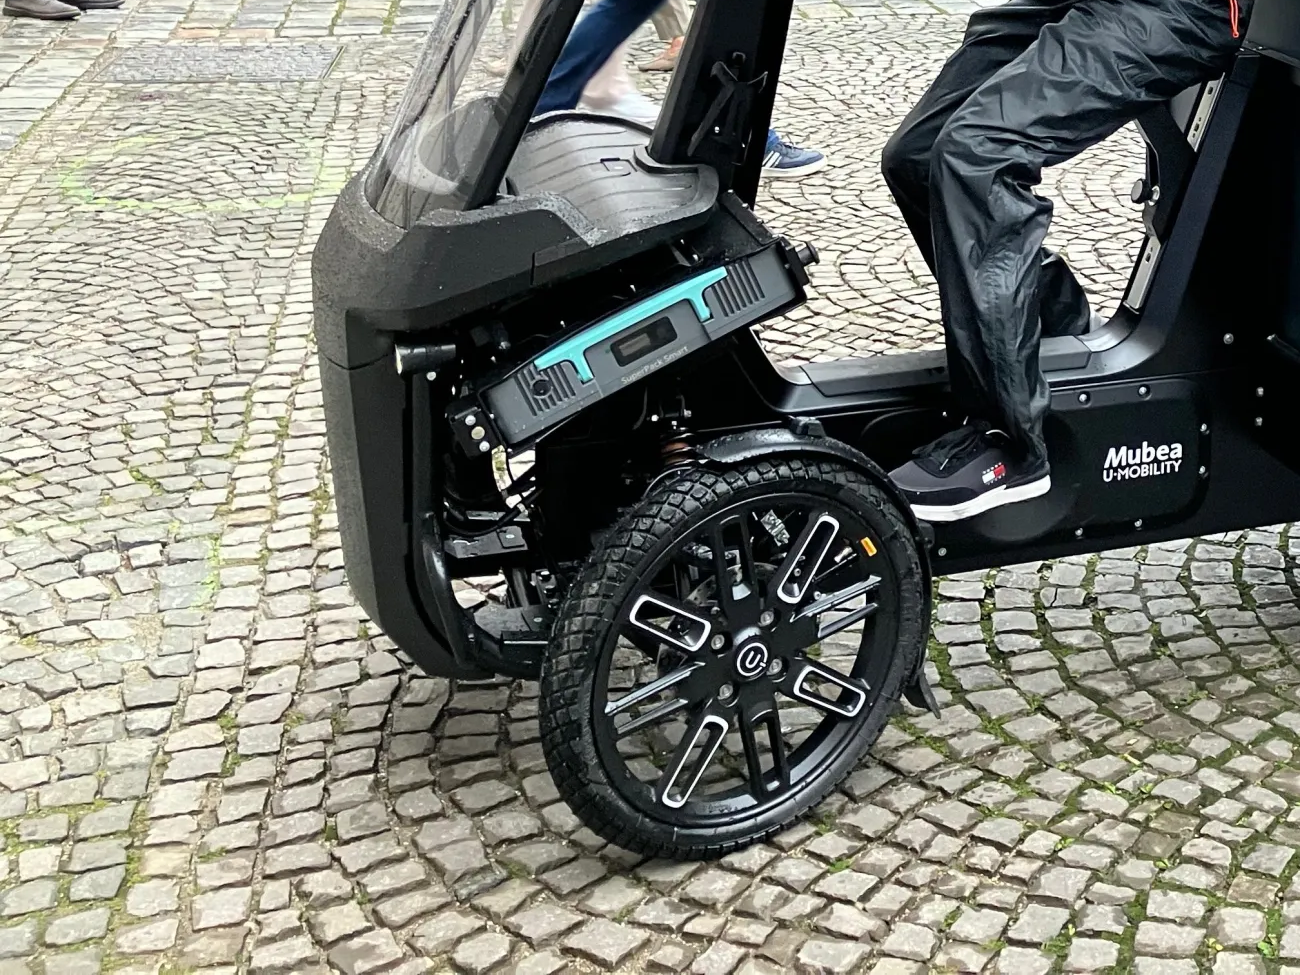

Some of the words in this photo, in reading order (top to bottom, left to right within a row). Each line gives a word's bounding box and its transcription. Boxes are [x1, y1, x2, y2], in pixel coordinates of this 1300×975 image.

[620, 358, 663, 385] SuperPack
[663, 345, 689, 363] Smart
[1103, 440, 1183, 469] Mubea
